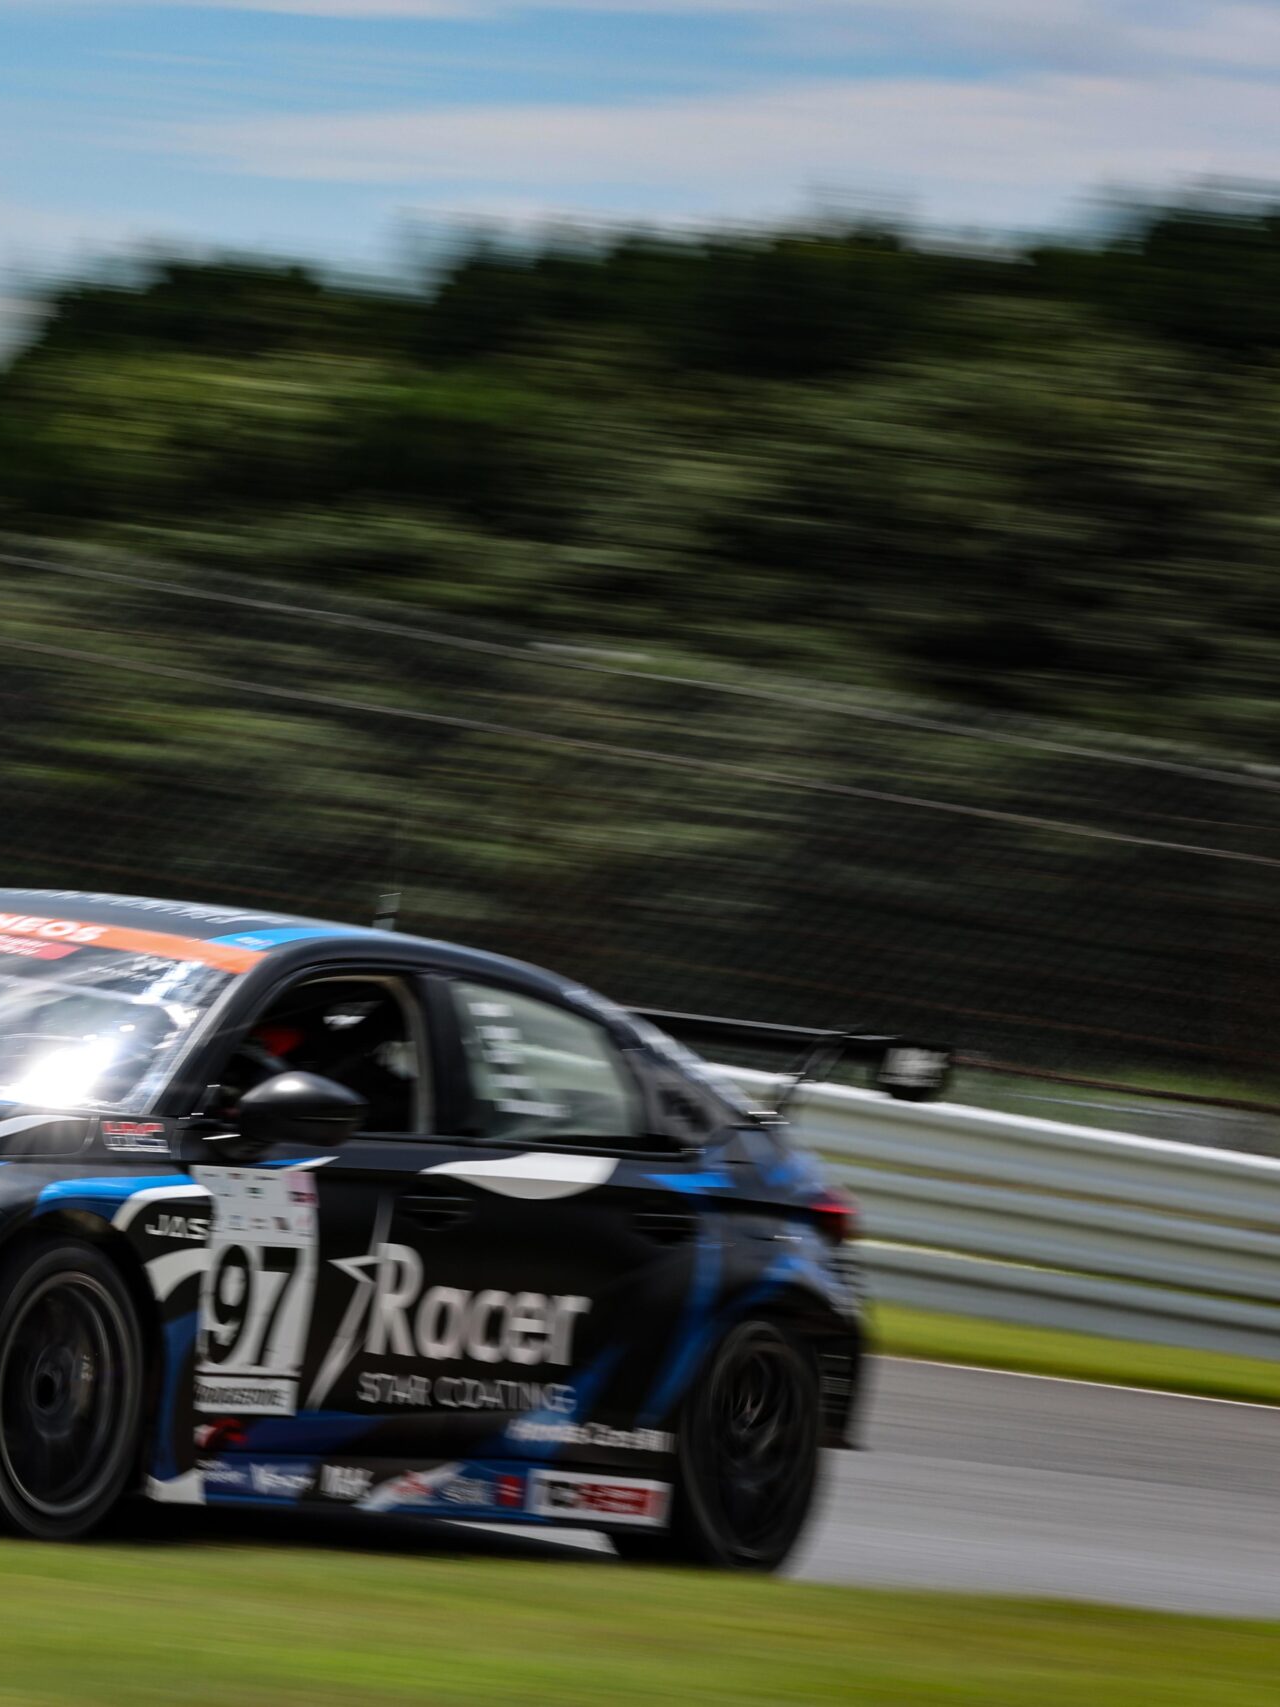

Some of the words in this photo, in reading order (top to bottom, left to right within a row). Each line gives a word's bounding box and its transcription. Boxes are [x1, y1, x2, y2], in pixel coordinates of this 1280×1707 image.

[201, 1244, 299, 1367] 97
[364, 1242, 593, 1366] Racer
[356, 1371, 432, 1407] STAR
[434, 1376, 577, 1414] COATING
